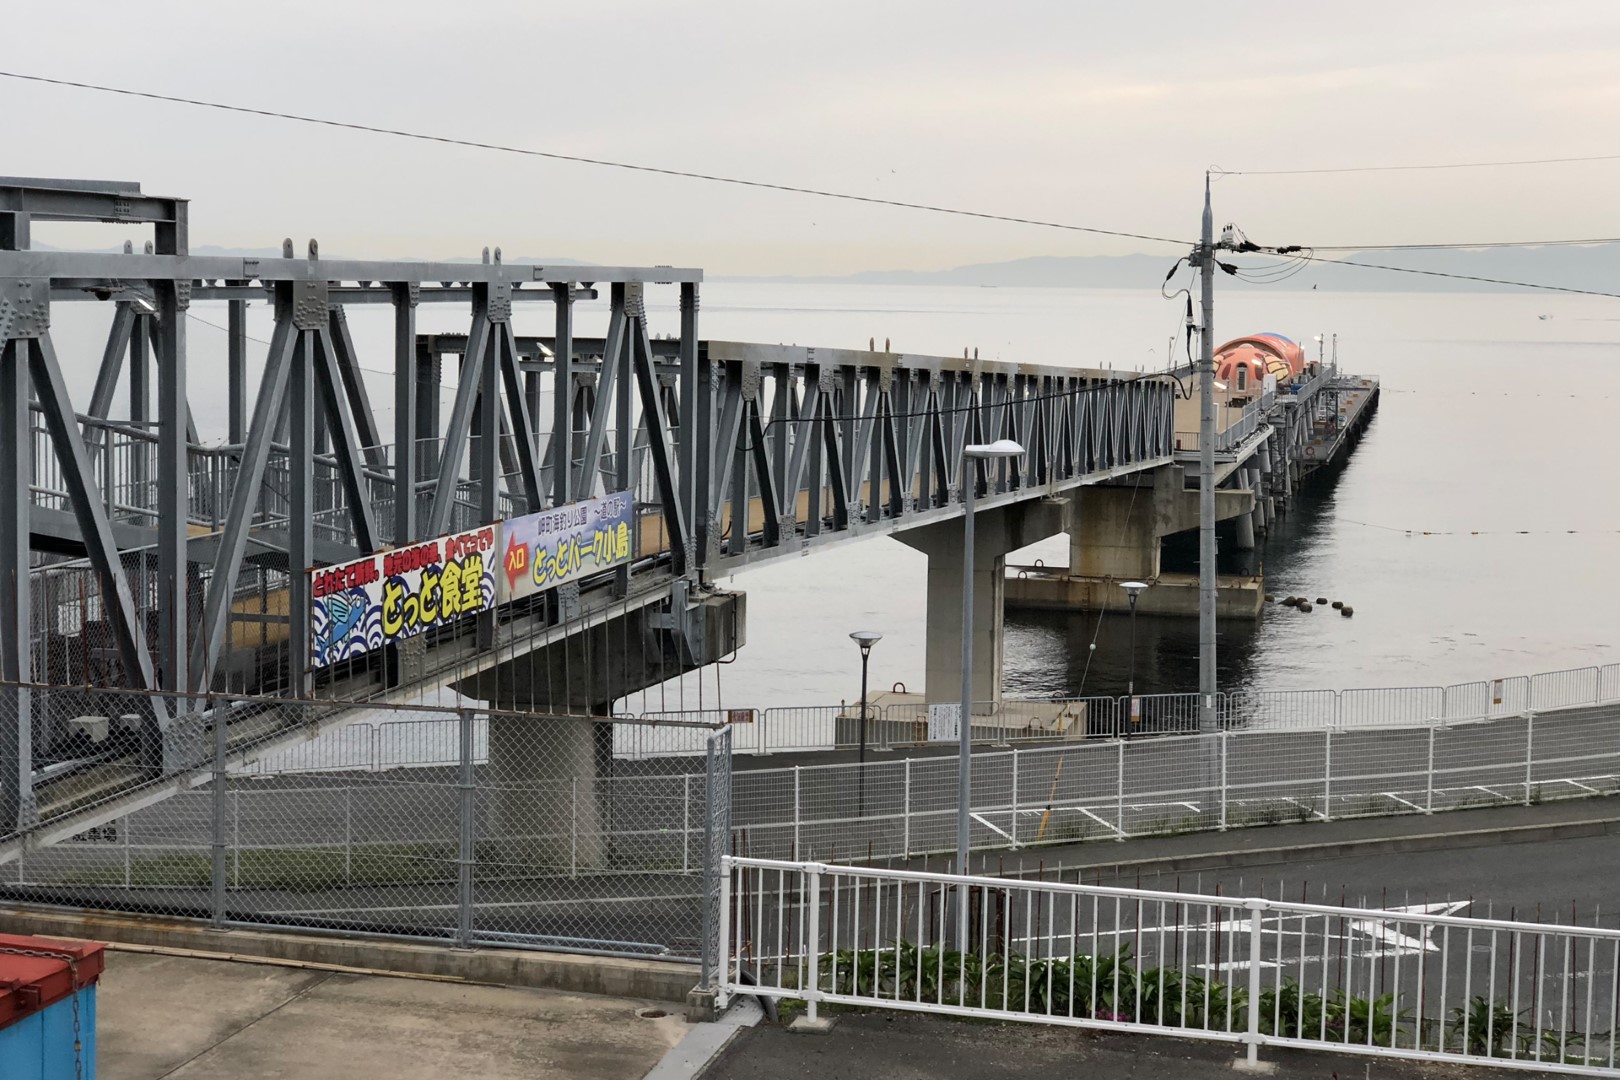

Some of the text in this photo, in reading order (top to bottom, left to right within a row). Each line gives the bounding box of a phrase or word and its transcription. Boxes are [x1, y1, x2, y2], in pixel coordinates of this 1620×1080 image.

[538, 506, 587, 536] 岬町海釣り公園
[508, 547, 525, 572] 入口
[533, 520, 630, 587] とっとパーク小島
[381, 552, 483, 638] とっと食堂
